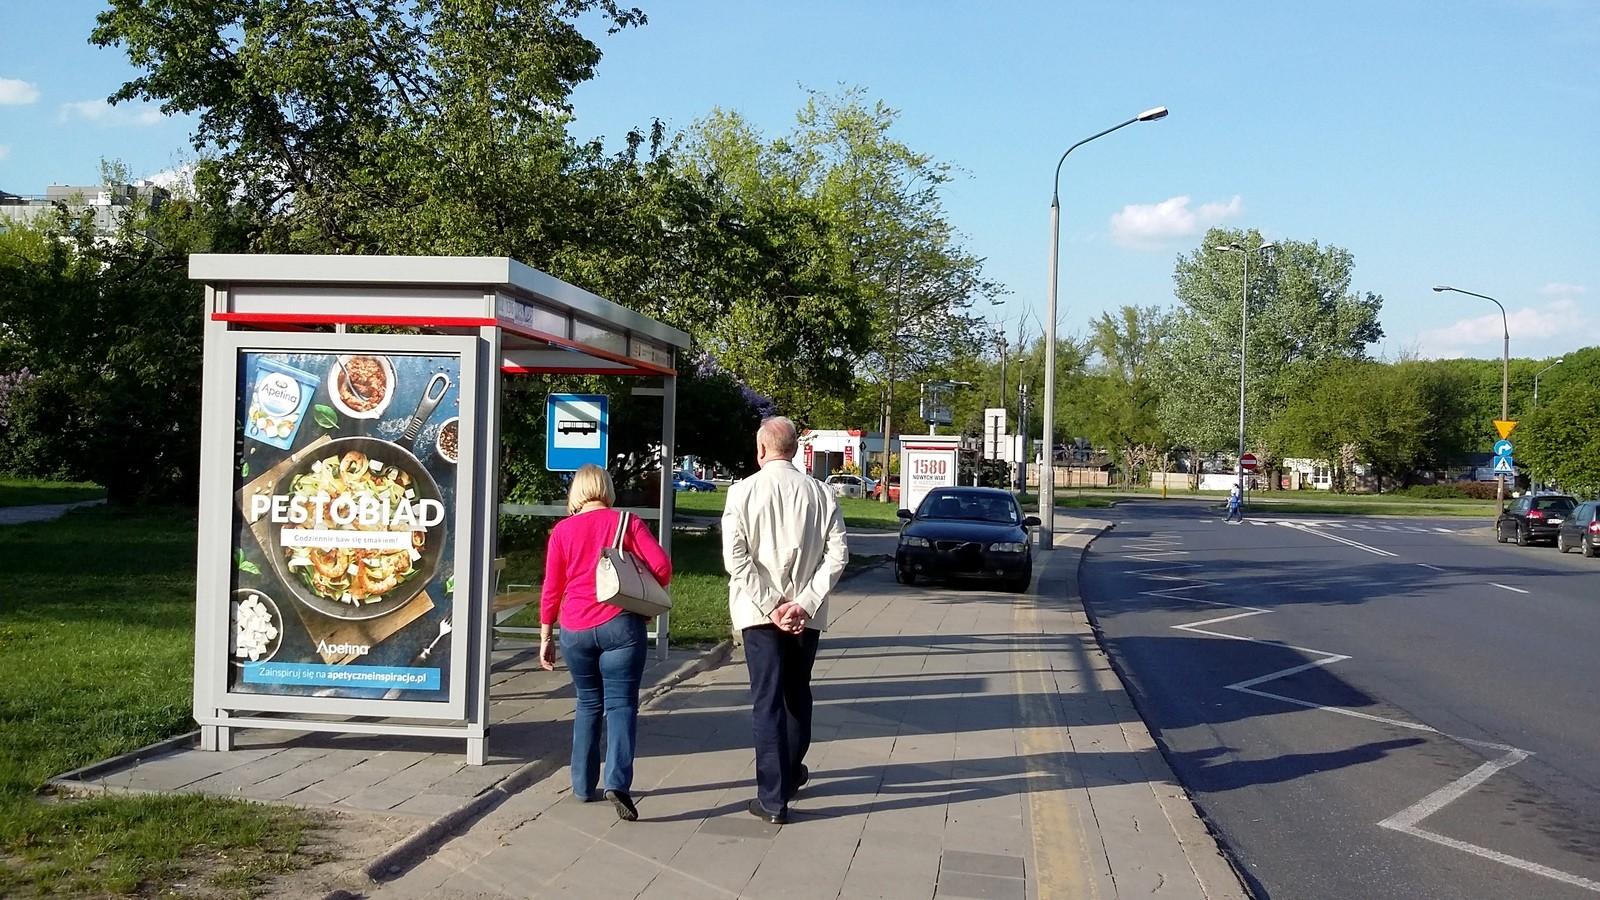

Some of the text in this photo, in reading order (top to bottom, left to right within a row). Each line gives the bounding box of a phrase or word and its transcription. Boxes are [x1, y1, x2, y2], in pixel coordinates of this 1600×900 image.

[261, 383, 297, 403] Apetina
[913, 459, 946, 474] 1580
[293, 533, 399, 545] Codziennie baw się smakiem!
[316, 639, 370, 656] Apetina
[259, 667, 426, 683] Zainspiruj się na apetyczneinspiracje.pl
